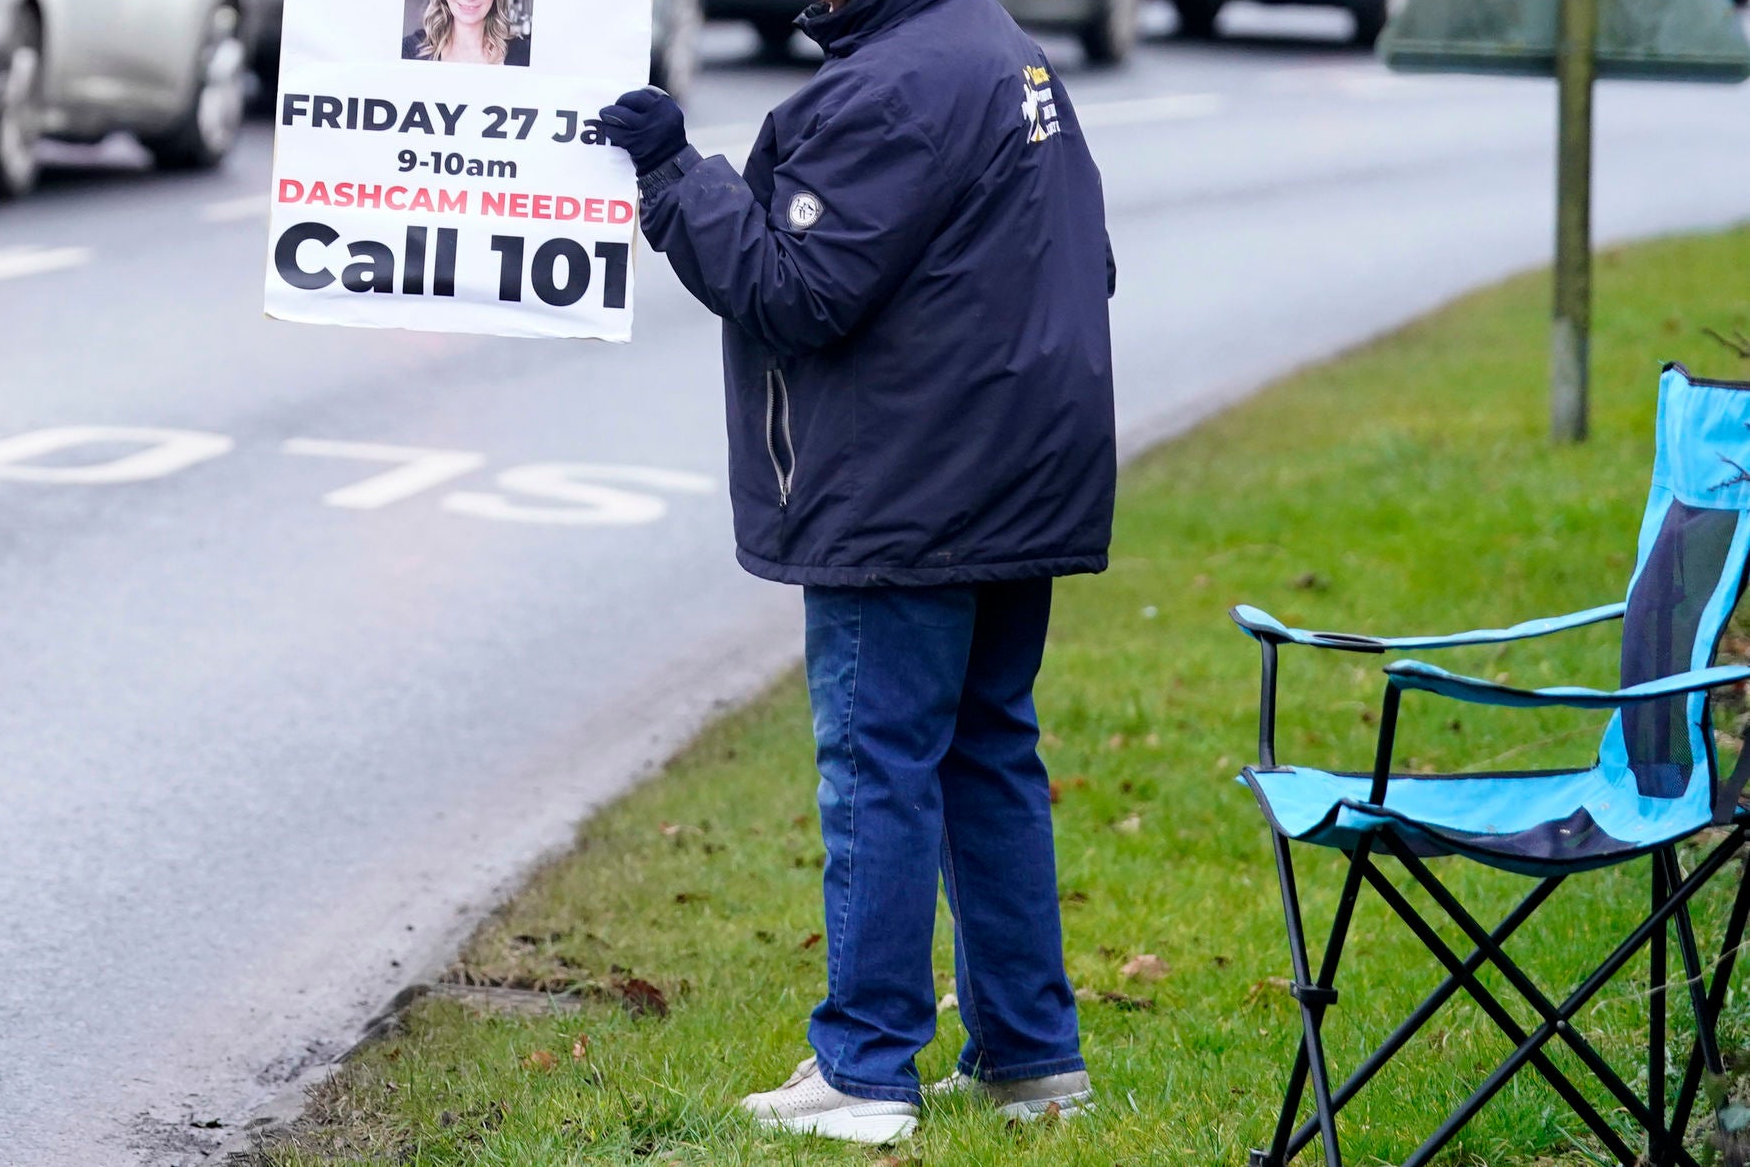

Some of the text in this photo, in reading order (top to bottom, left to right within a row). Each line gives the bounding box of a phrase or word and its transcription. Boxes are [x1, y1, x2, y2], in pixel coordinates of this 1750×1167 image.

[281, 93, 618, 146] FRIDAY 27 Ja
[397, 149, 518, 179] 9-10am
[277, 178, 634, 225] DASHCAM NEEDED
[274, 221, 630, 310] Call 101
